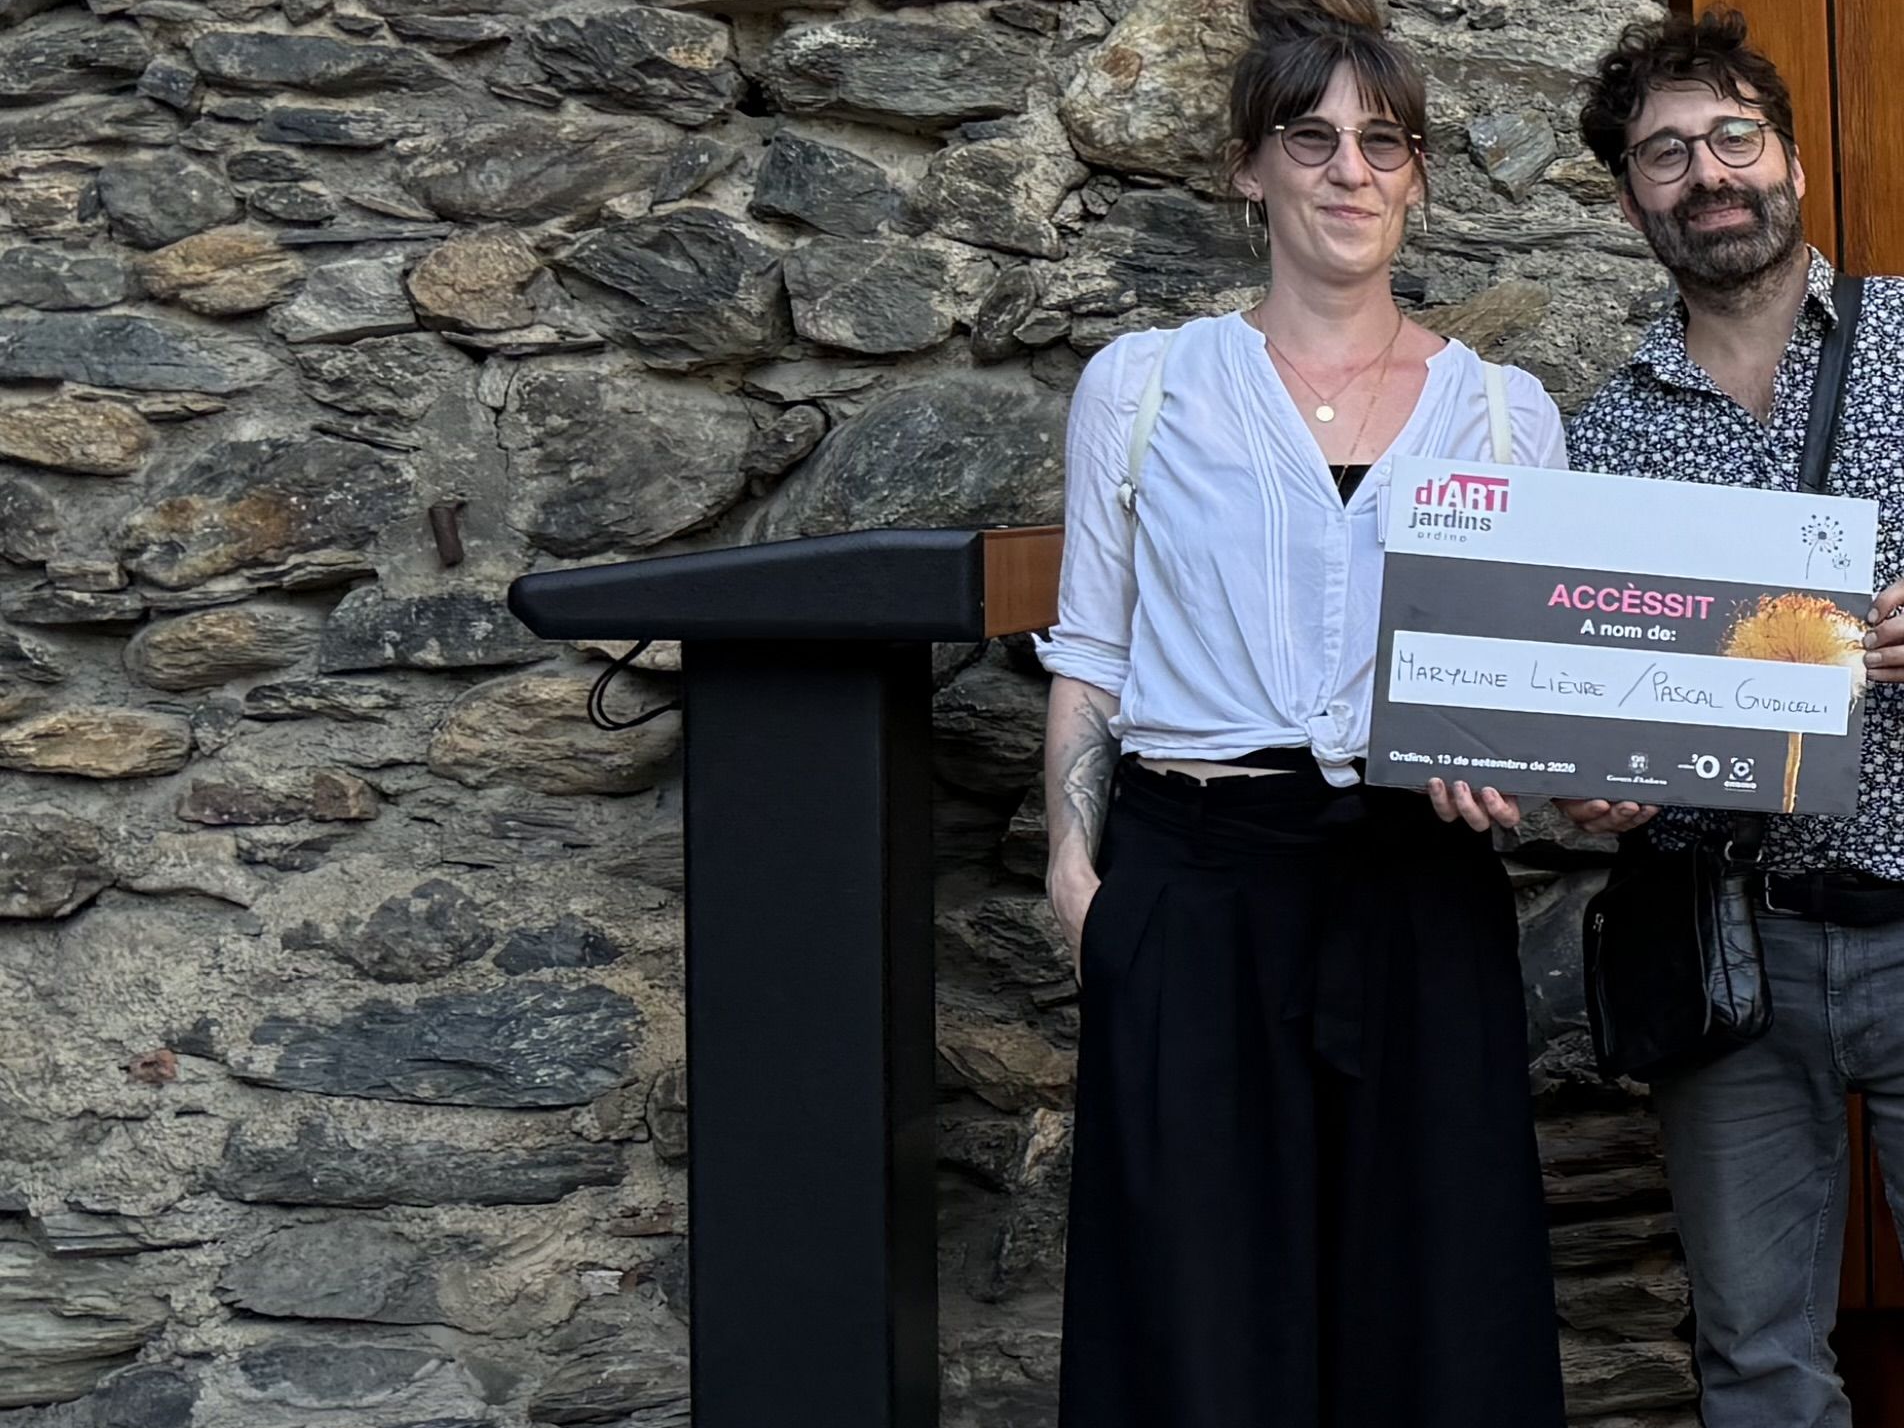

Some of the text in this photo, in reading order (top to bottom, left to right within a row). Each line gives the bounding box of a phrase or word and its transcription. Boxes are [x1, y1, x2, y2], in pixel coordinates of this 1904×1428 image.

[1415, 474, 1510, 513] d'ART
[1408, 507, 1493, 532] jardins
[1417, 531, 1468, 543] ordino
[1547, 582, 1716, 620] ACCÈSSIT
[1580, 619, 1677, 641] A nom de:
[1389, 750, 1433, 765] Ordino,
[1453, 755, 1469, 766] de
[1471, 758, 1528, 770] setembre
[1529, 760, 1545, 771] de
